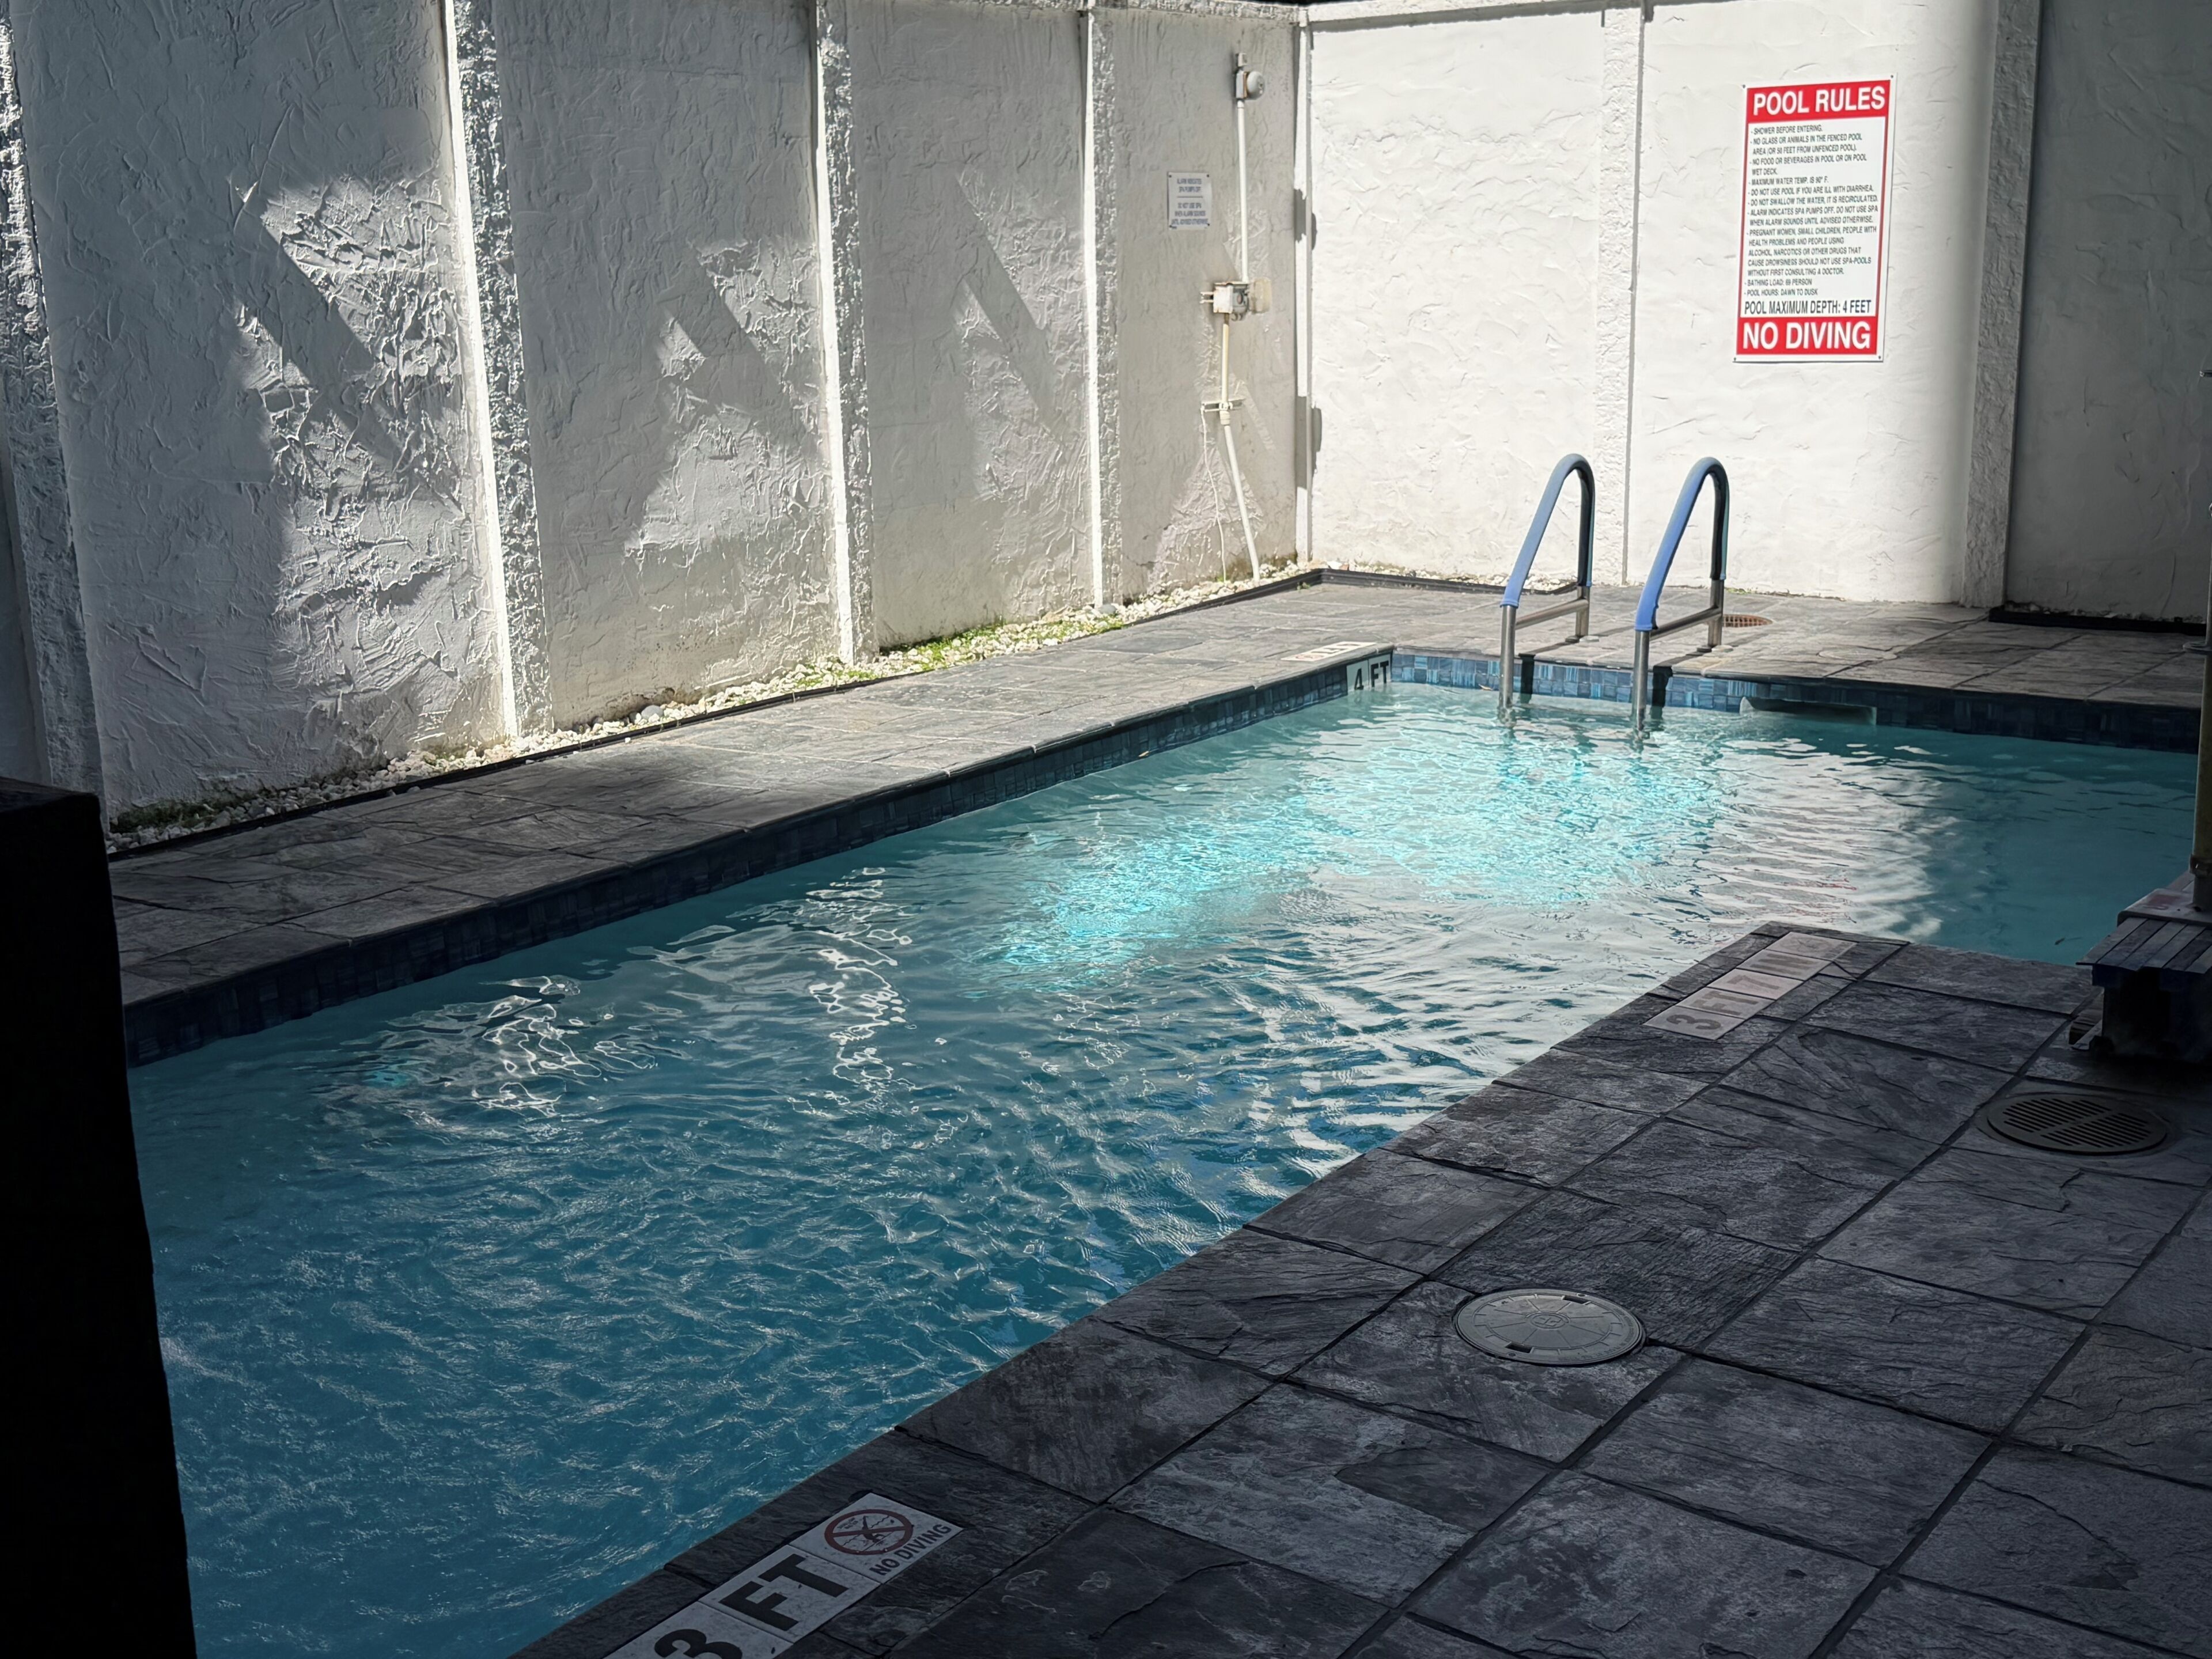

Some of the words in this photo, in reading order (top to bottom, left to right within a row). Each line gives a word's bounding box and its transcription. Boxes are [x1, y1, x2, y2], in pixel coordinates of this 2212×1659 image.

[1753, 91, 1809, 116] POOL
[1815, 86, 1885, 112] RULES
[1753, 126, 1775, 134] SHOWER
[1787, 135, 1809, 143] ANIMALS
[1827, 133, 1847, 141] FENCED
[1848, 132, 1862, 140] POOL
[1752, 147, 1766, 155] AREA
[1812, 143, 1839, 152] UNFENCED
[1760, 157, 1774, 165] FOOD
[1775, 156, 1782, 164] OR
[1783, 155, 1813, 164] BEVERAGES
[1815, 154, 1820, 162] IN
[1820, 154, 1834, 162] POOL
[1853, 153, 1866, 161] POOL
[1751, 177, 1774, 185] MAXIMUM
[1770, 197, 1794, 205] SWALLOW
[1768, 237, 1795, 245] PROBLEMS
[1811, 247, 1828, 255] OTHER
[1765, 257, 1797, 266] DROWSINESS
[1744, 300, 1766, 313] POOL
[1768, 300, 1808, 313] MAXIMUM
[1810, 300, 1840, 313] DEPTH:
[1843, 300, 1847, 313] 4
[1850, 300, 1871, 313] FEET
[1743, 321, 1778, 350] NO
[1786, 321, 1871, 349] DIVING
[1354, 668, 1364, 690] 4
[1370, 660, 1389, 687] FT
[1727, 975, 1780, 990] 7
[1692, 990, 1759, 1016] FT
[1666, 1014, 1721, 1030] 3
[869, 1558, 900, 1575] NO
[894, 1524, 952, 1559] DIVING
[654, 1628, 743, 1659] 3
[718, 1554, 850, 1631] FT
